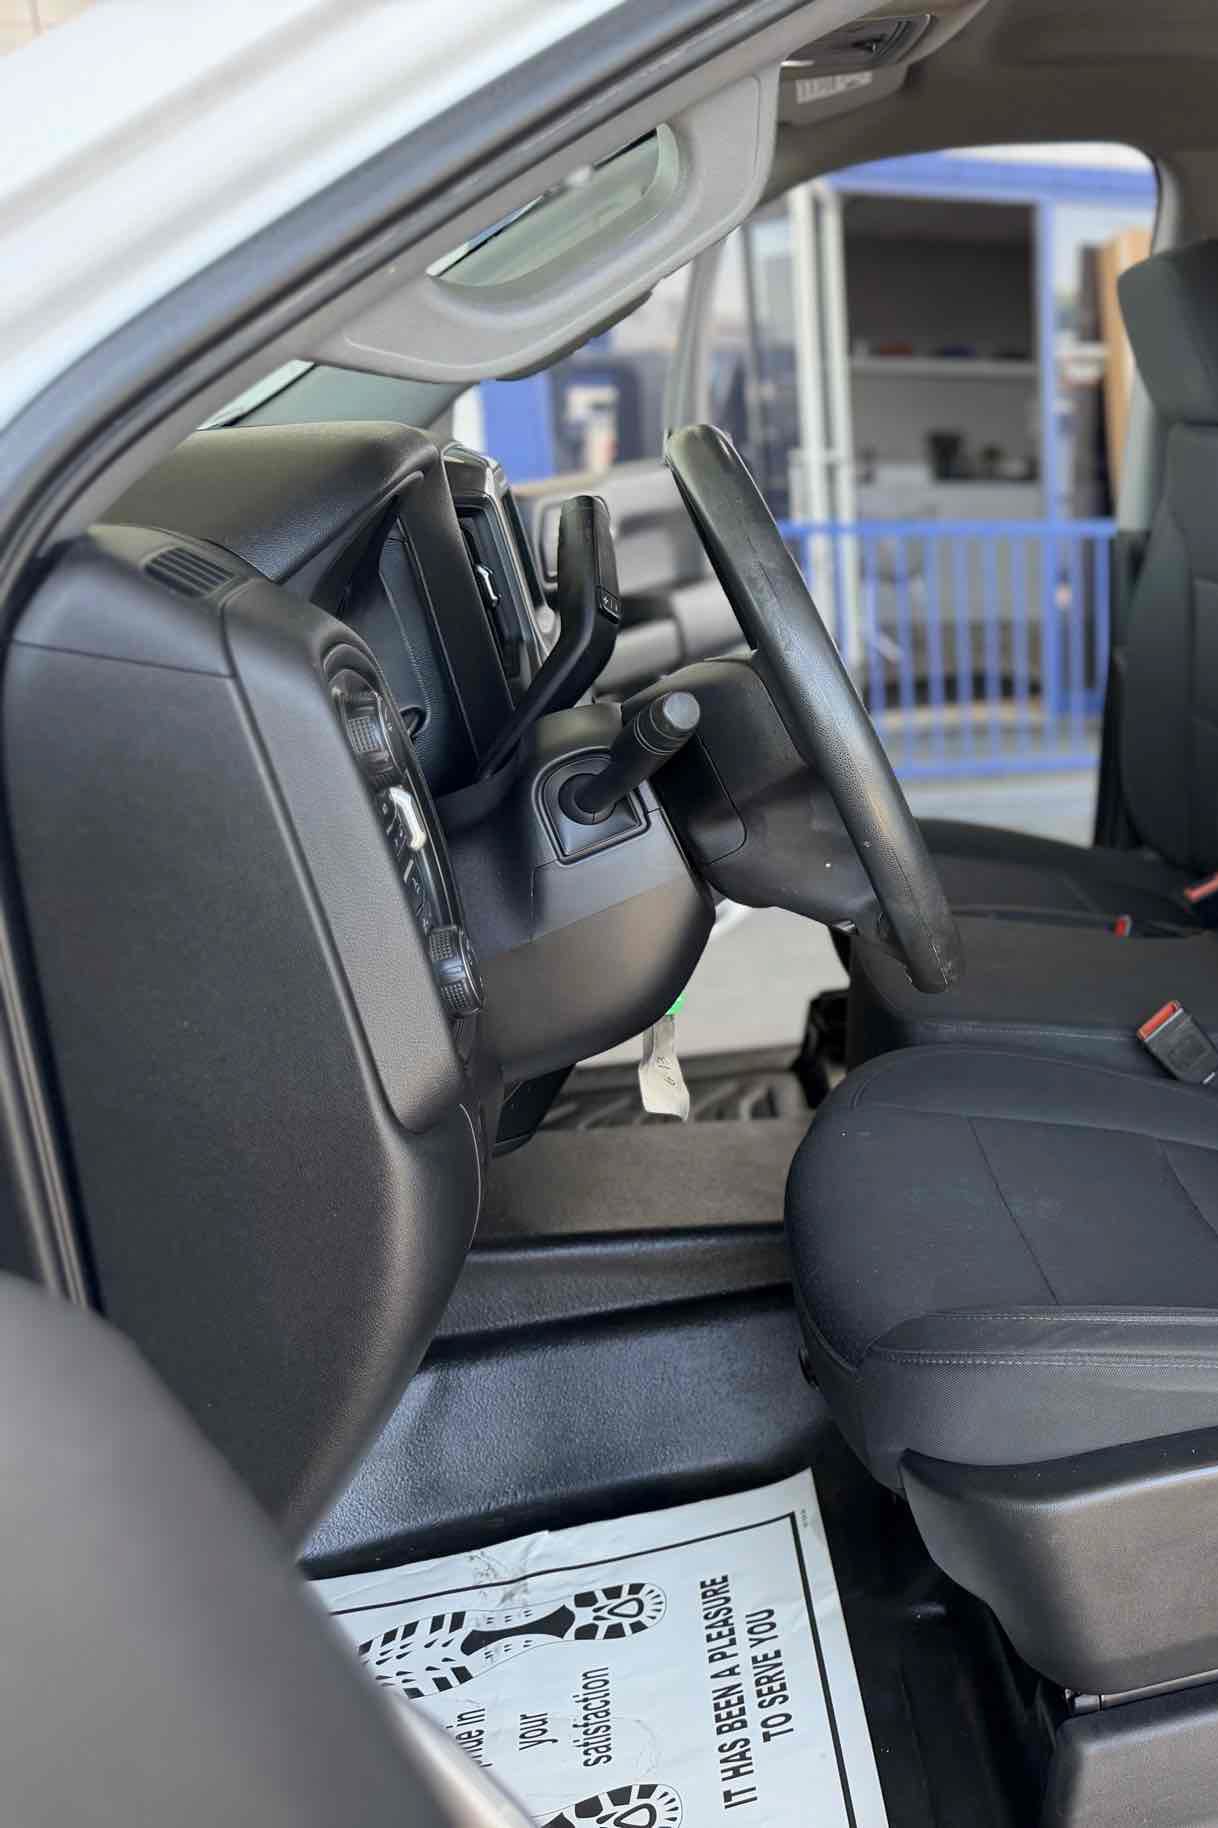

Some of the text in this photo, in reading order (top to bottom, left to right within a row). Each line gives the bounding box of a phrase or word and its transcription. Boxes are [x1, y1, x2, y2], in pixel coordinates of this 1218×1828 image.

[446, 1708, 485, 1728] in
[573, 1667, 612, 1767] satisfaction
[700, 1574, 758, 1809] IT HAS BEEN A PLEASURE
[745, 1608, 794, 1743] TO SERVE YOU
[519, 1712, 558, 1751] your
